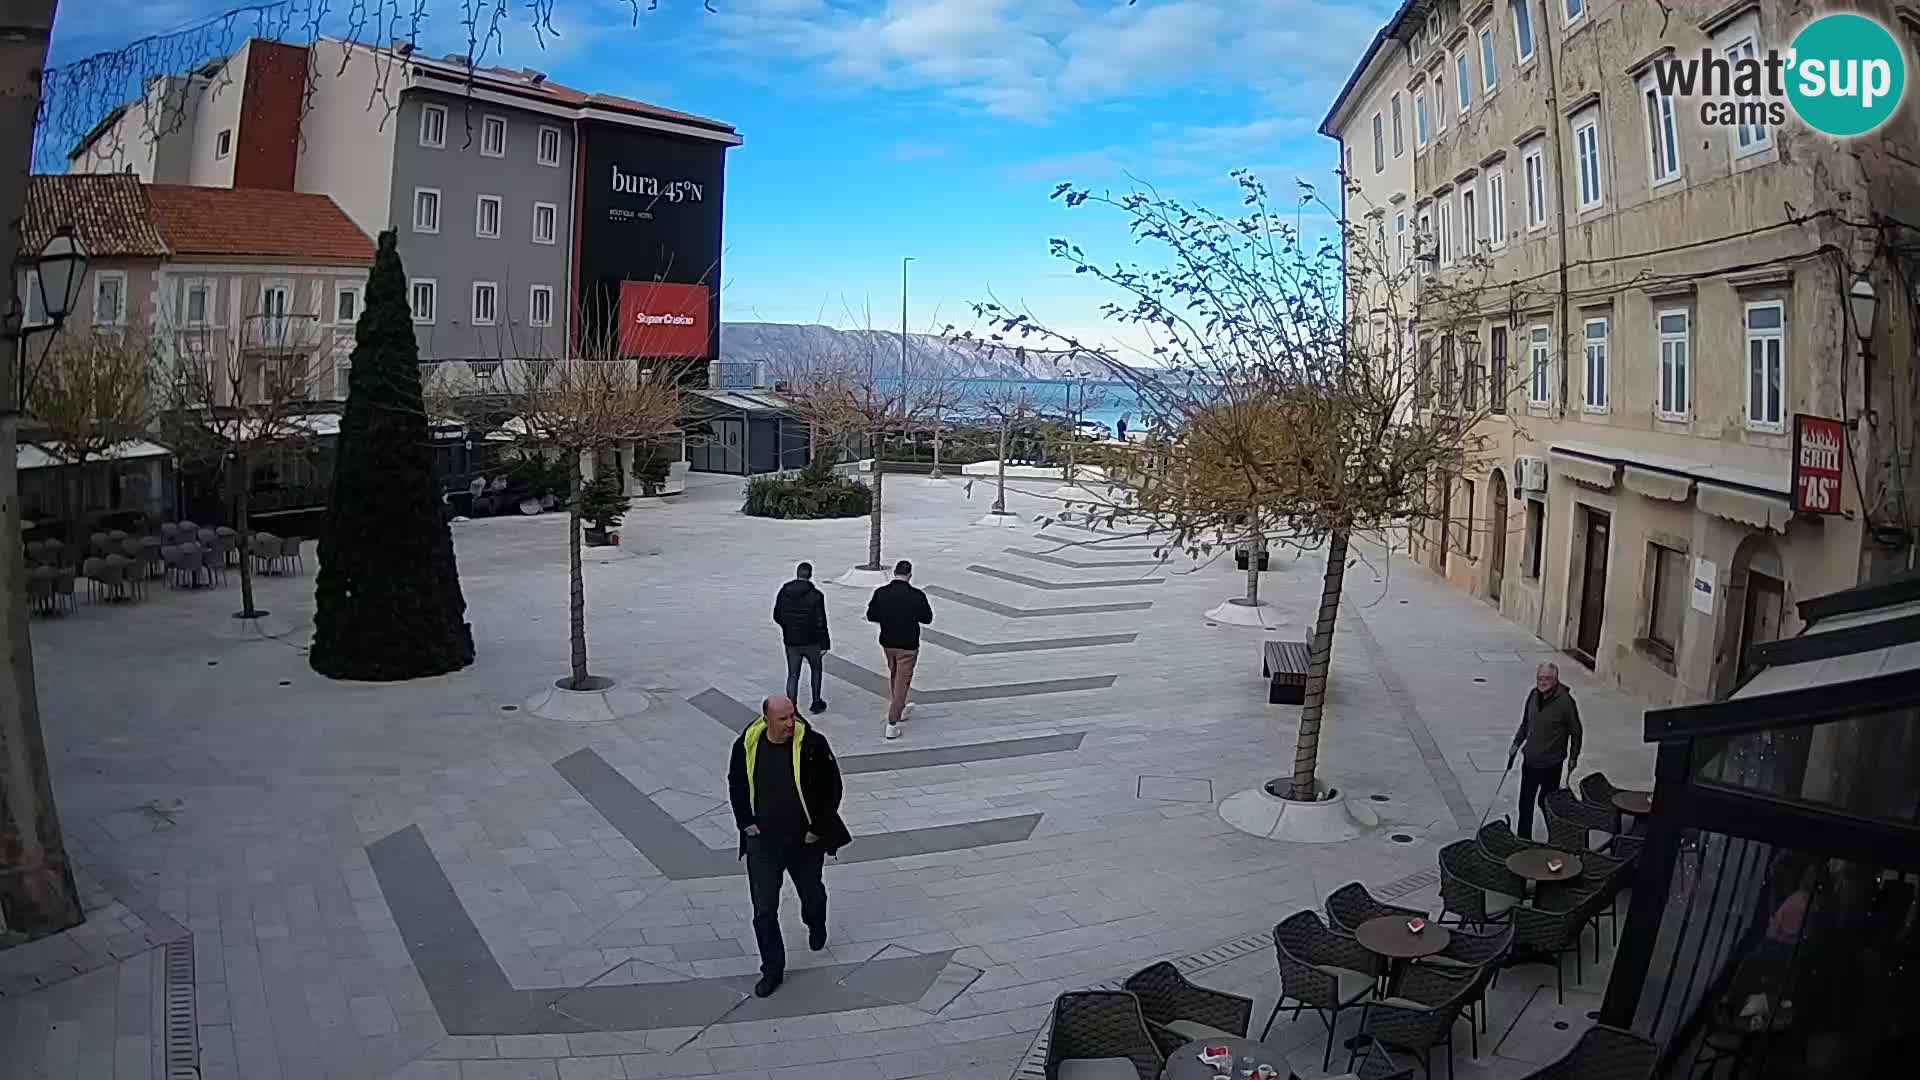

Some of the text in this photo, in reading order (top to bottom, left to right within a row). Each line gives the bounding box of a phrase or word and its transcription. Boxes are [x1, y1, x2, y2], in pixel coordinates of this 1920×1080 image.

[612, 165, 659, 196] bura
[1800, 447, 1840, 471] GRILL
[1799, 475, 1839, 509] "AS"
